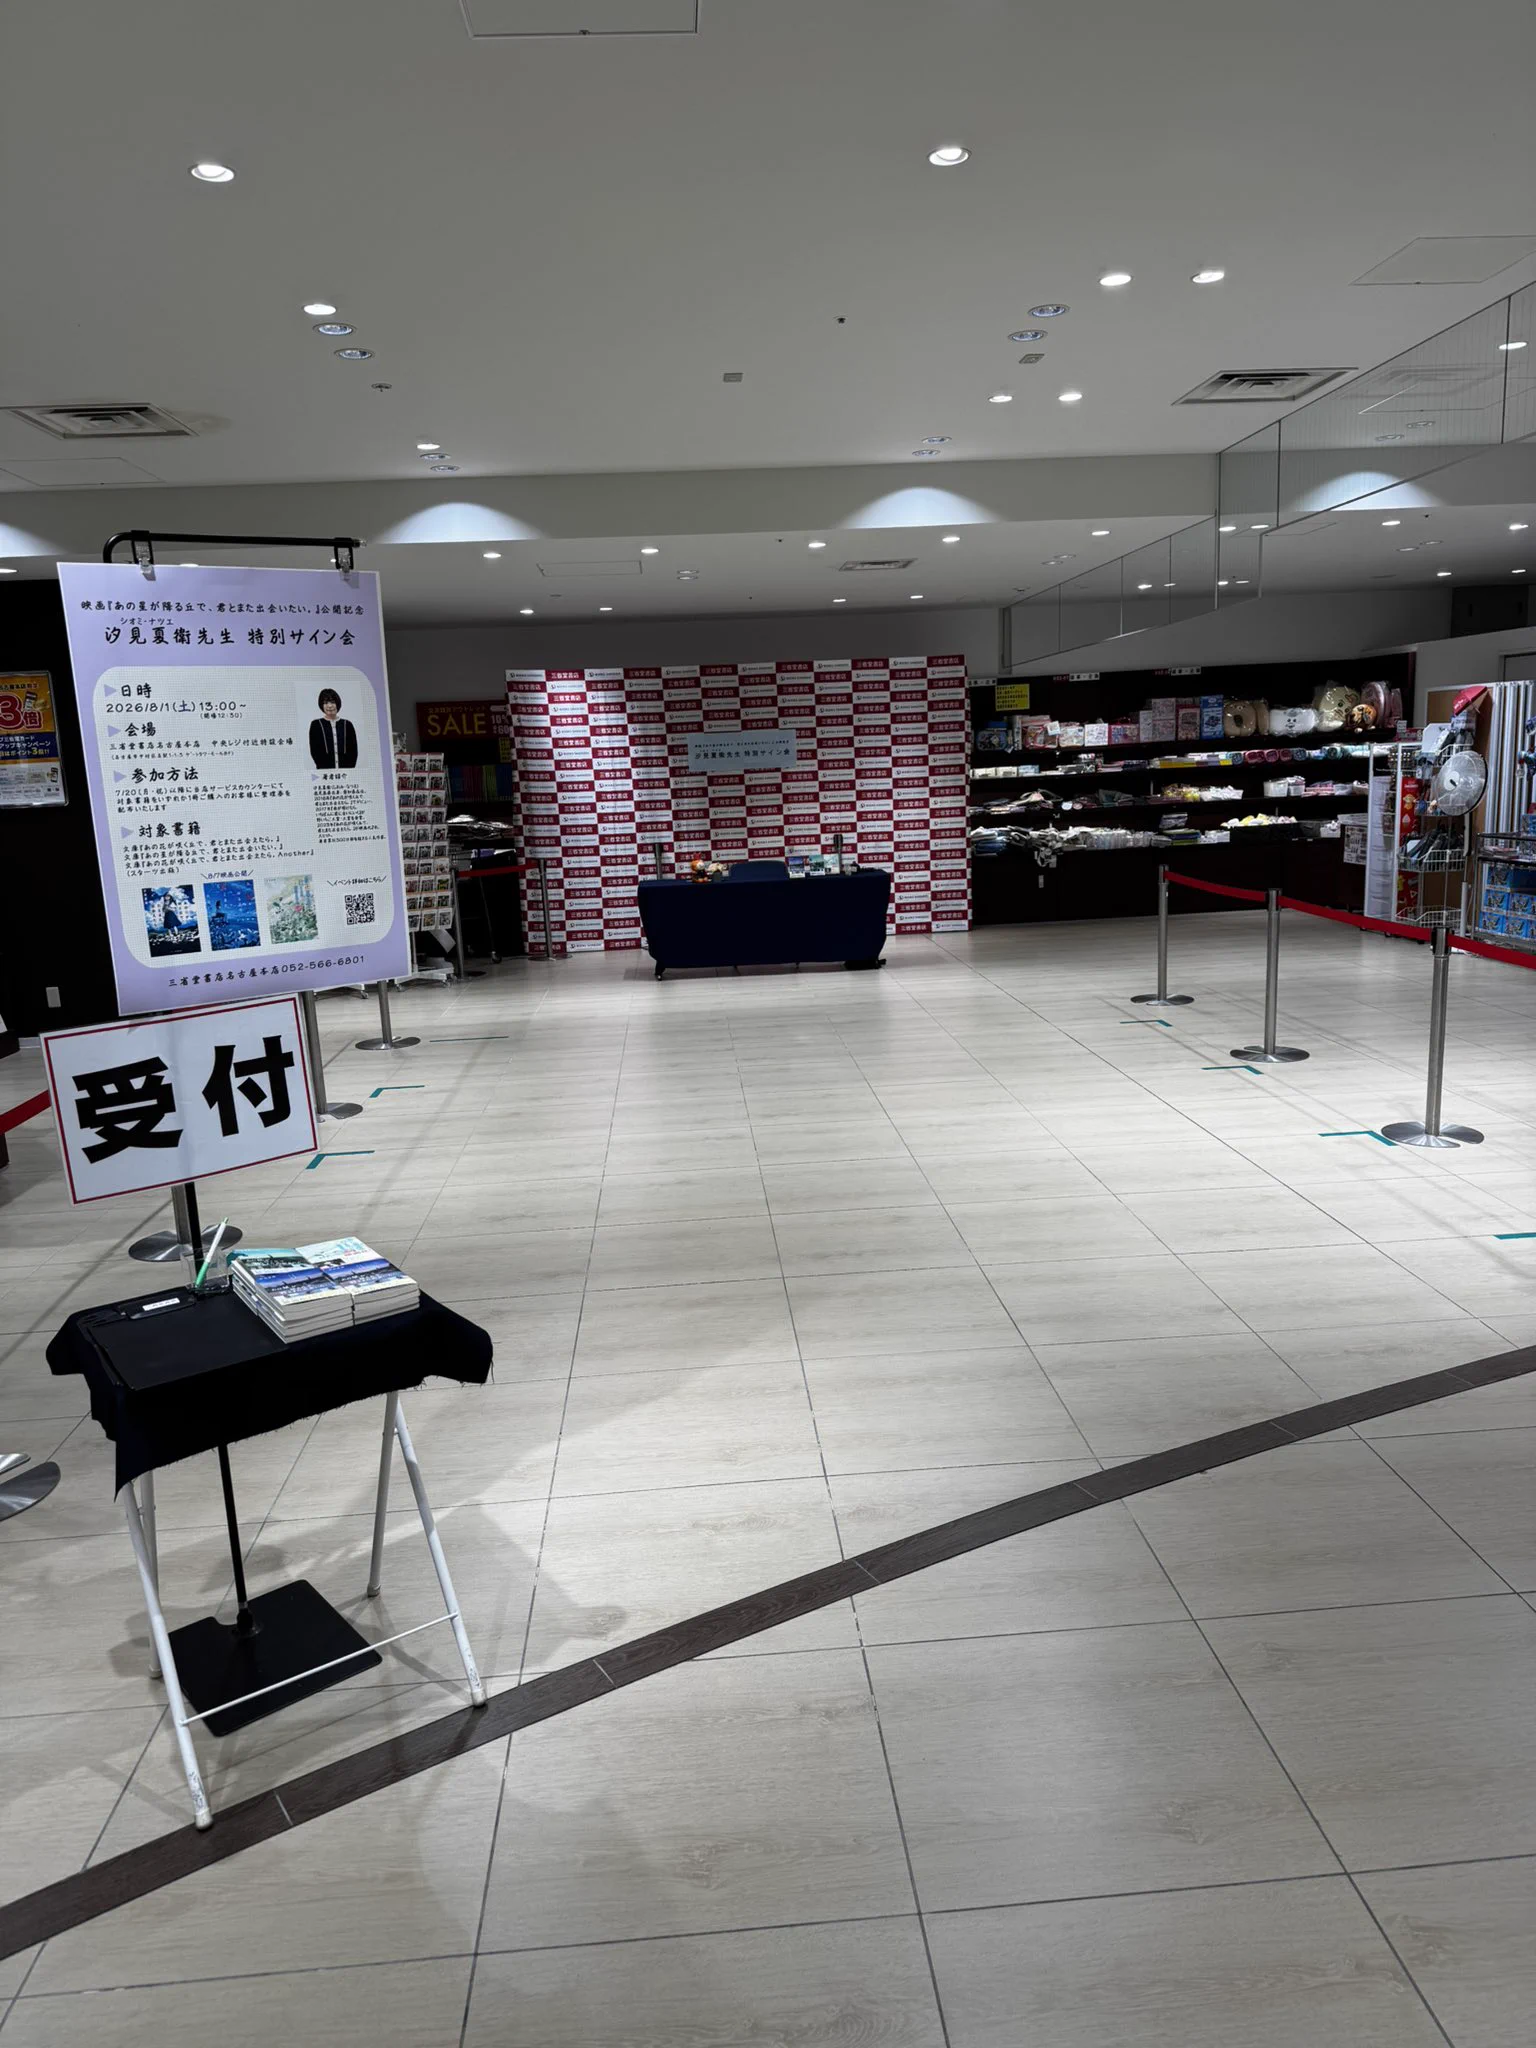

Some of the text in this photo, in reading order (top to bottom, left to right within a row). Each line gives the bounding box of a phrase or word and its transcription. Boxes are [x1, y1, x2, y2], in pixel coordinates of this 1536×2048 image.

[105, 626, 356, 646] 汐見夏衛先生 特別サイン会
[121, 682, 152, 698] 日時
[124, 722, 157, 737] 会場
[427, 712, 488, 736] SALE
[132, 766, 200, 784] 参加方法
[138, 821, 201, 838] 対象書籍
[72, 1034, 296, 1164] 受付
